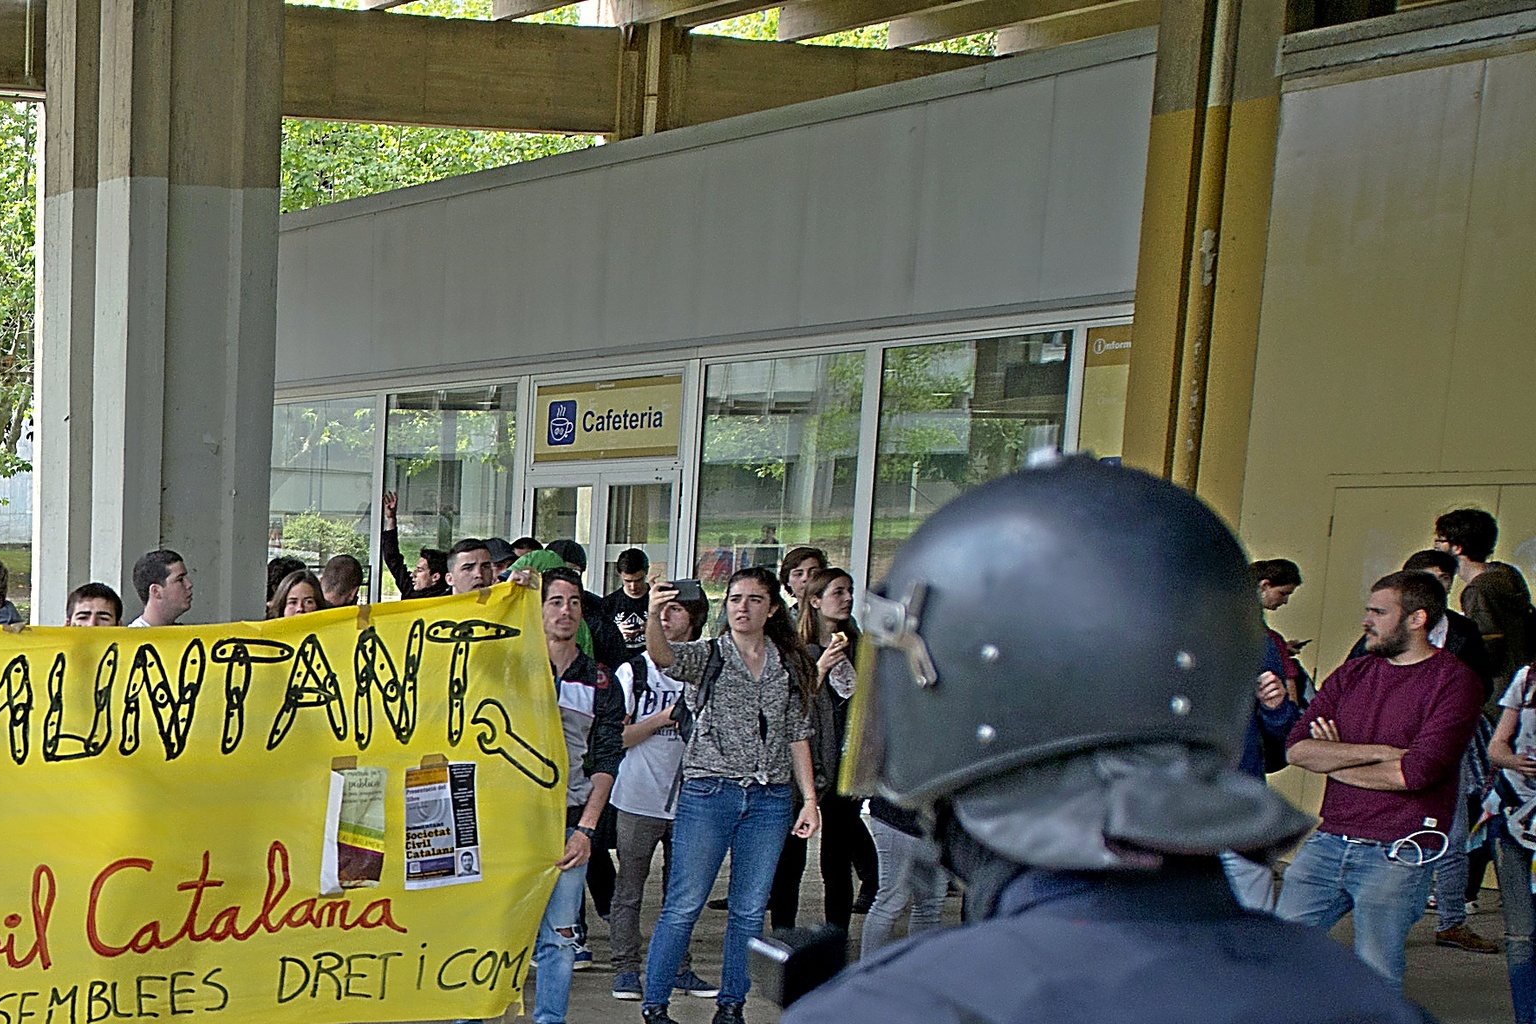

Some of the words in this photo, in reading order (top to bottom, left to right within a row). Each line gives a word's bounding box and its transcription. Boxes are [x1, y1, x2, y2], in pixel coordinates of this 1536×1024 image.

[582, 405, 664, 433] Cafeteria
[406, 827, 451, 841] Societat
[406, 838, 432, 851] Civil
[406, 846, 455, 860] Catalana
[85, 840, 408, 958] Catalana
[277, 950, 403, 1004] DRET
